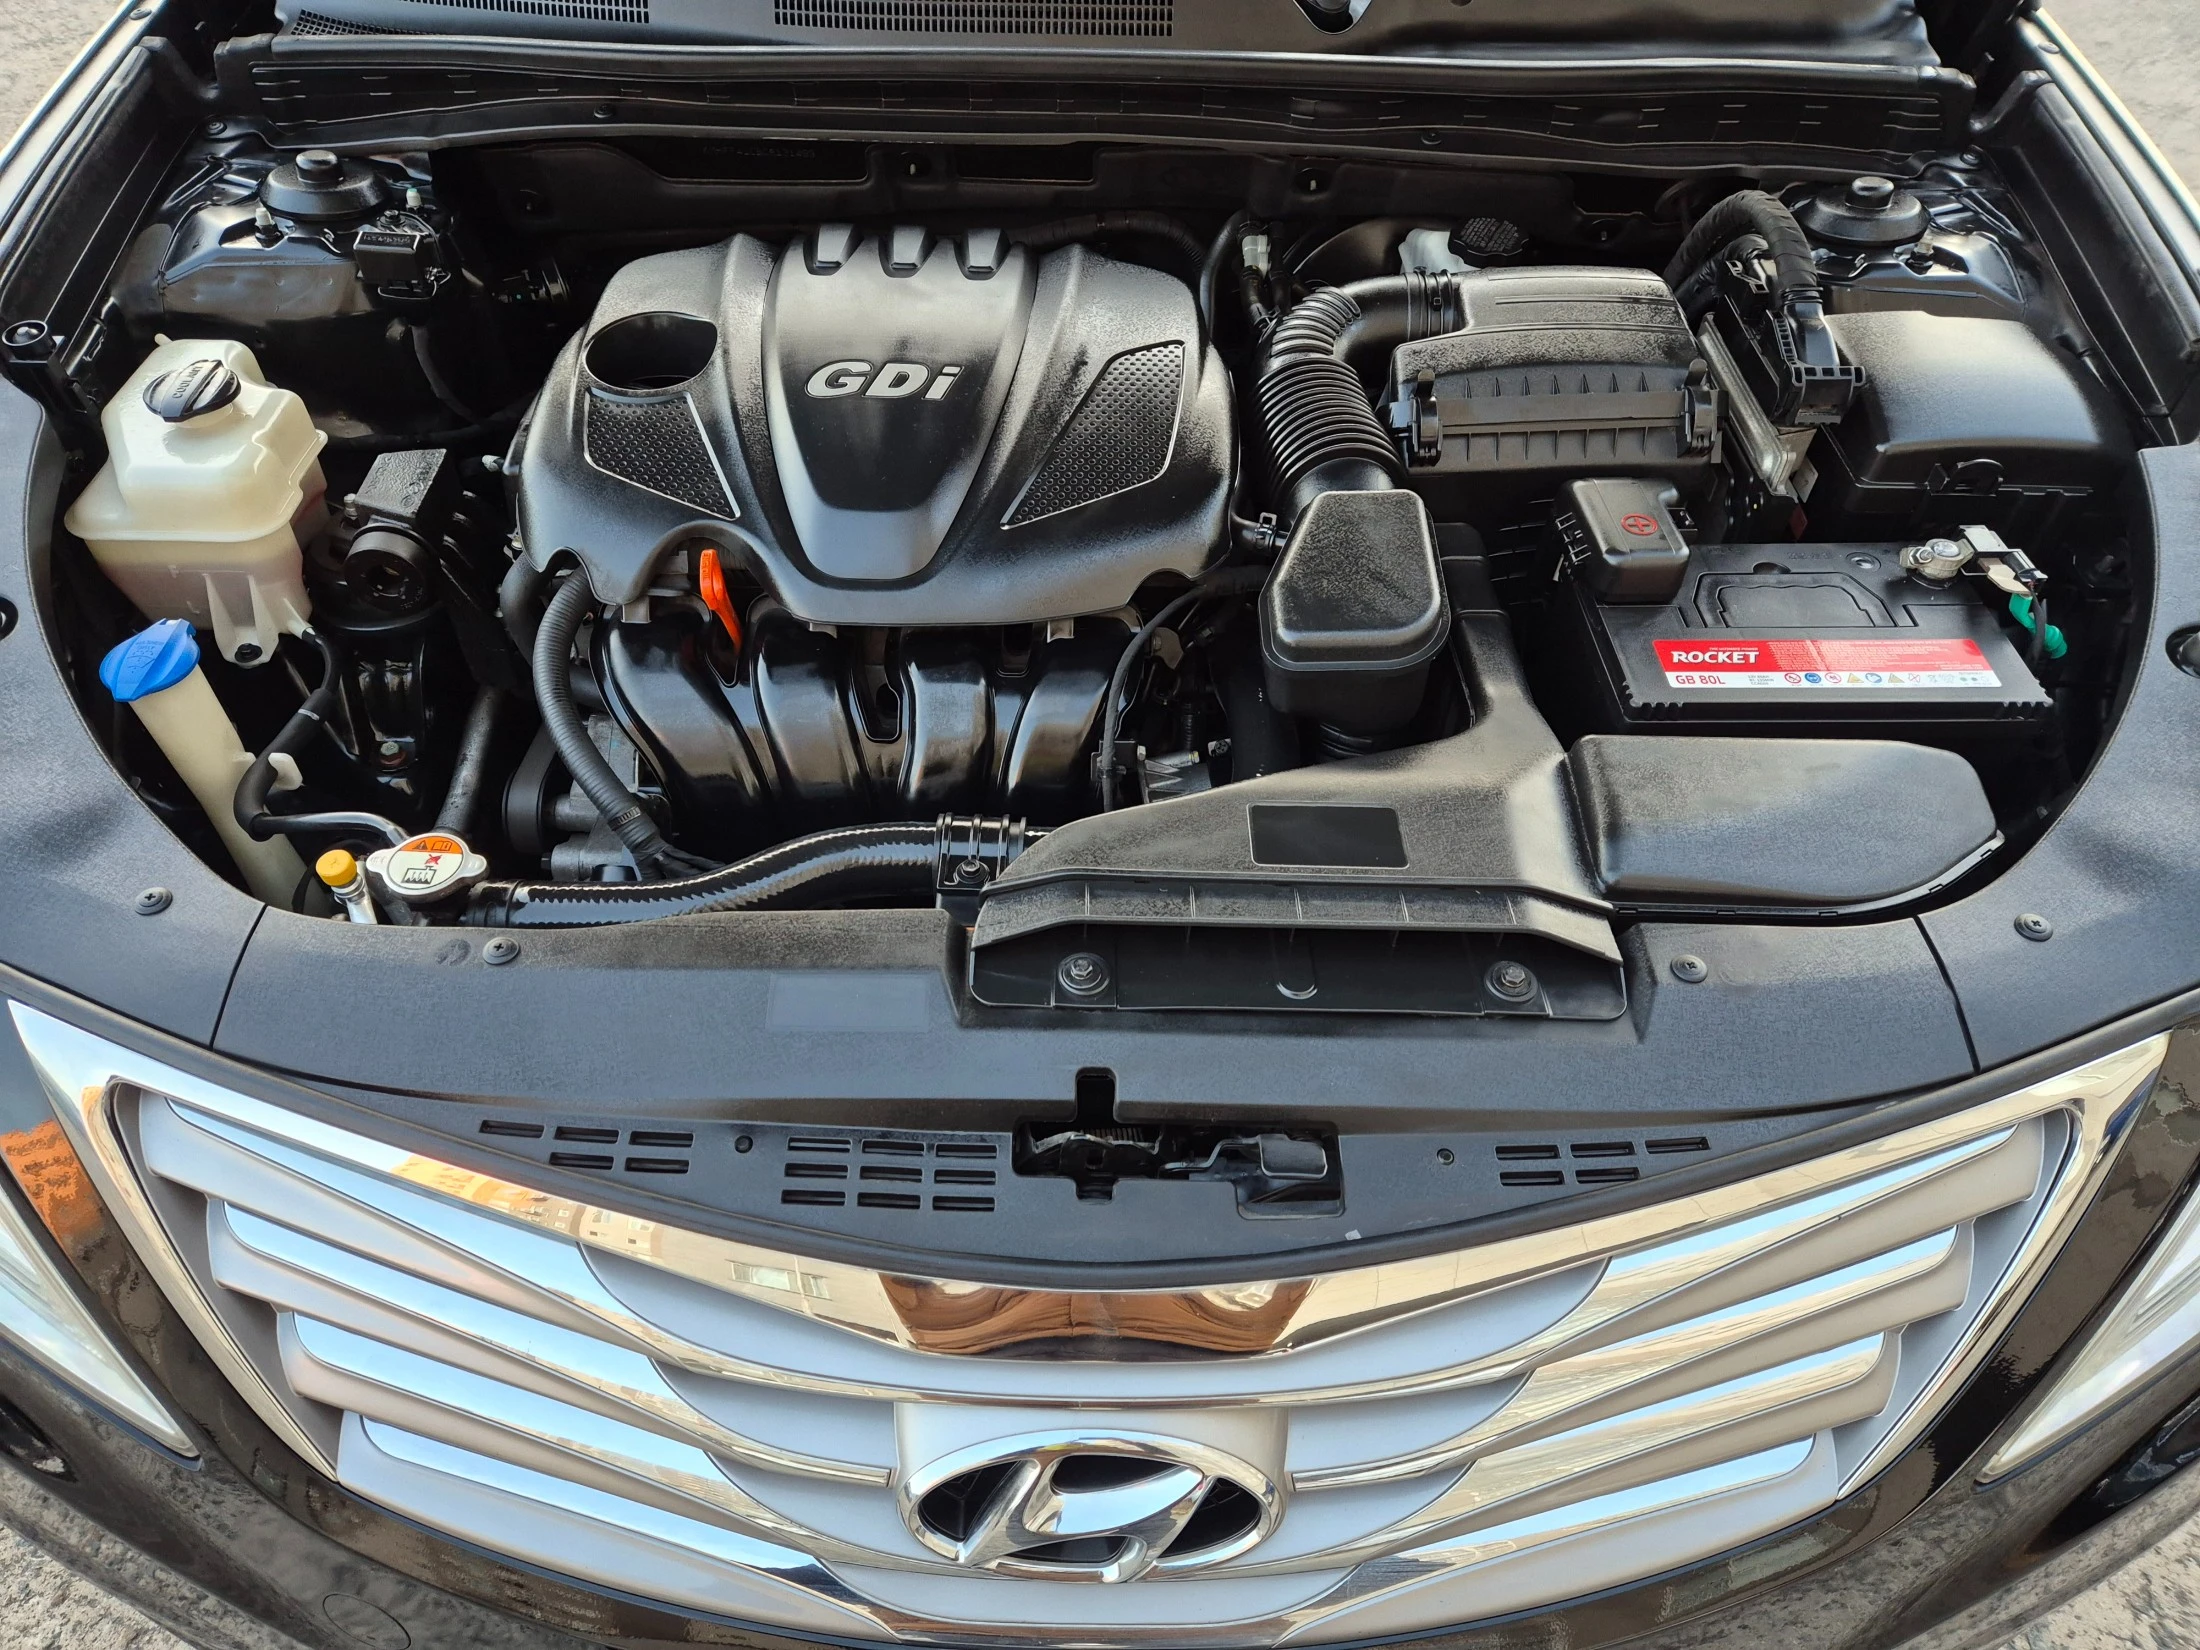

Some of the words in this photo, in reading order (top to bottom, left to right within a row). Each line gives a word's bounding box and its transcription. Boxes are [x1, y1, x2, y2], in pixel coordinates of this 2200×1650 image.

[805, 360, 964, 400] GDi
[1671, 651, 1759, 664] ROCKET
[1675, 675, 1696, 685] GB
[1699, 675, 1726, 685] 80L
